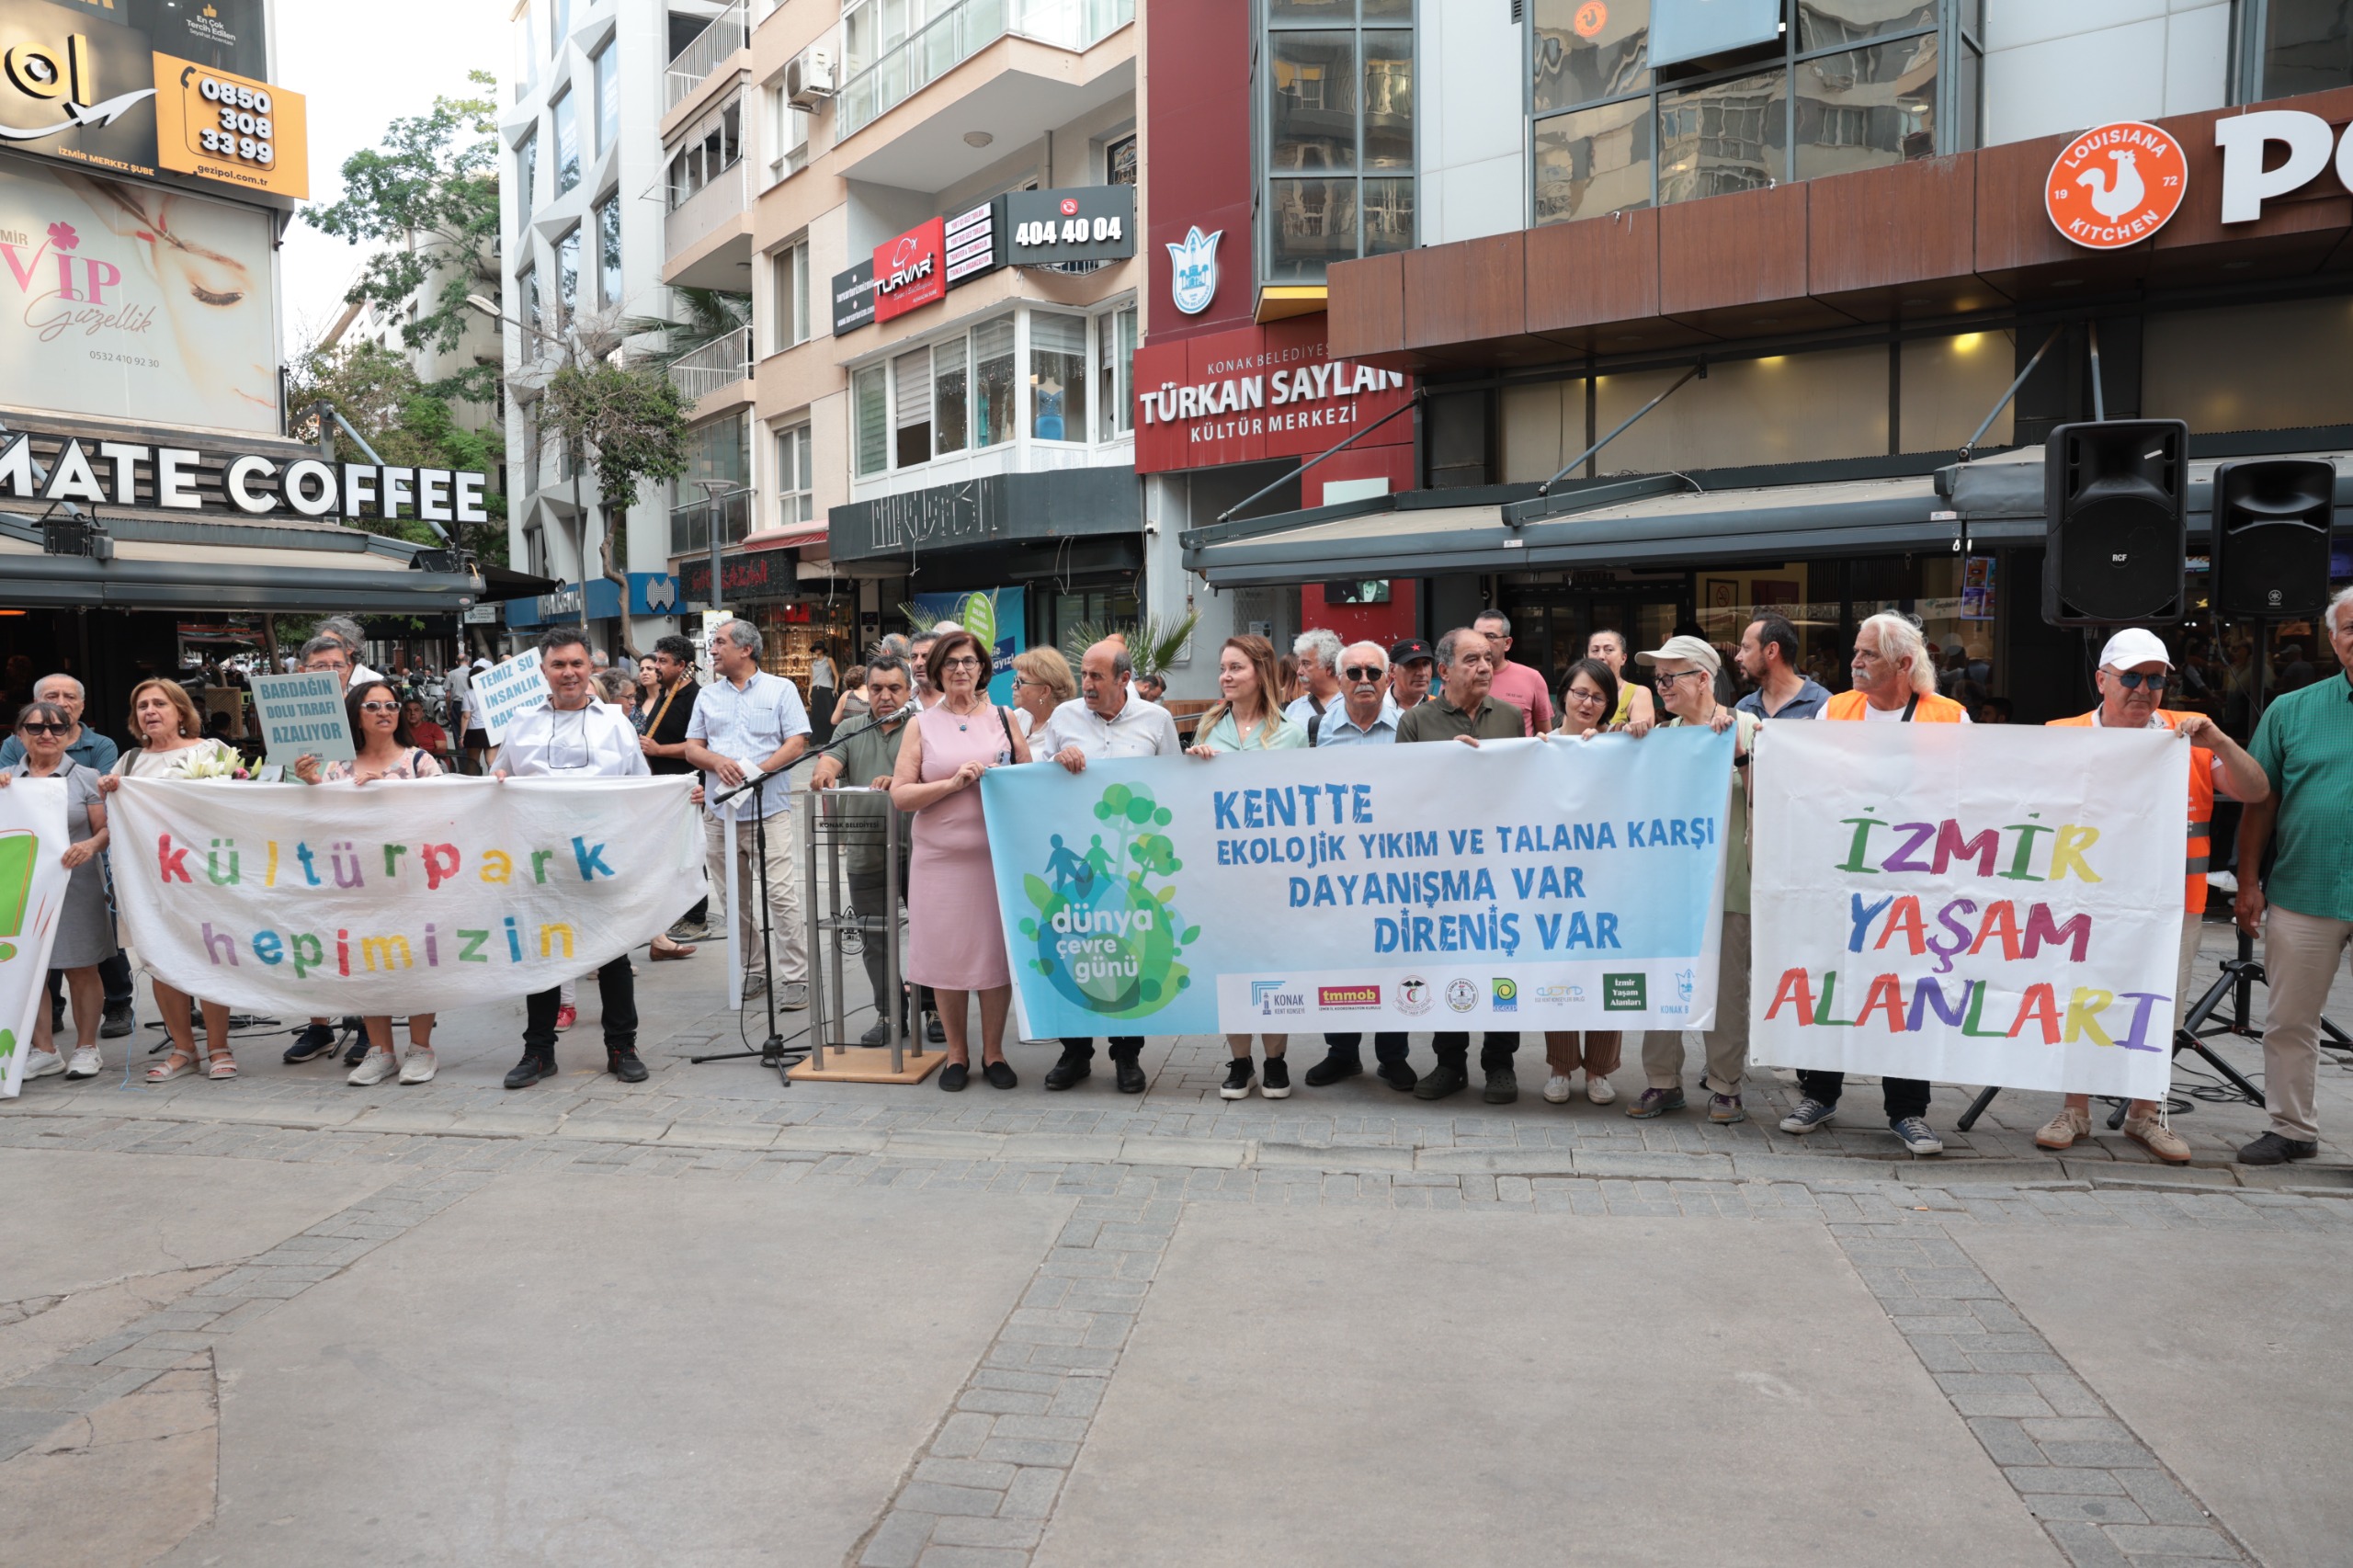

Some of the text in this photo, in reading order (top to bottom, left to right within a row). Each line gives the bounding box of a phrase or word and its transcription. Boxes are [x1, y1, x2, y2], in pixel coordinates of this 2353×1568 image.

[186, 19, 236, 41] Tercih Edilen
[197, 15, 224, 29] En Çok
[199, 77, 271, 114] 0850
[219, 108, 273, 139] 308
[58, 145, 154, 176] İZMİR MERKEZ ŞUBE
[200, 128, 274, 164] 33 99
[2063, 129, 2168, 169] LOUISIANA
[198, 165, 268, 187] gezipol.com.tr
[2163, 176, 2178, 187] 72
[2215, 109, 2353, 223] P
[2054, 188, 2068, 200] 19
[1016, 216, 1122, 246] 404 40 04
[2068, 209, 2160, 241] KITCHEN
[873, 257, 934, 296] TURVAR
[24, 289, 156, 342] Güzellik
[89, 350, 160, 368] 0532 410 92 30
[1208, 343, 1331, 375] KONAK BELEDİYES
[1140, 361, 1404, 424] TÜRKAN SAYLAN
[1191, 402, 1358, 443] KÜLTÜR MERKEZİ
[225, 454, 488, 523] COFFEE
[2112, 553, 2127, 562] RCF
[479, 654, 535, 689] TEMİZ SU
[259, 676, 334, 700] BARDAĞIN
[484, 674, 540, 710] İNSANLIK
[266, 700, 336, 719] DOLU TARAFI
[272, 722, 343, 744] AZALIYOR
[1213, 782, 1373, 830] KENTTE
[845, 820, 880, 828] BELEDİYESİ
[1217, 817, 1715, 869] EKOLOJİK YIKIM VE TALANA KARŞI
[1834, 806, 2103, 883] İZMİR
[157, 832, 616, 891] kültürpark
[1289, 865, 1586, 909] DAYANIŞMA VAR
[1051, 903, 1154, 937] dünya
[1374, 904, 1622, 958] DİRENİŞ VAR
[1847, 892, 2093, 973] YAŞAM
[201, 915, 575, 979] hepimizin
[1056, 938, 1117, 959] çevre
[1074, 955, 1139, 983] günü
[1614, 978, 1636, 986] İzmir
[1274, 994, 1304, 1006] KONAK
[1323, 988, 1377, 1002] tmmob
[1609, 998, 1642, 1006] Alanları
[1612, 989, 1639, 997] Yaşam
[1660, 1005, 1683, 1014] KONAK
[1764, 967, 2173, 1053] ALANLARI
